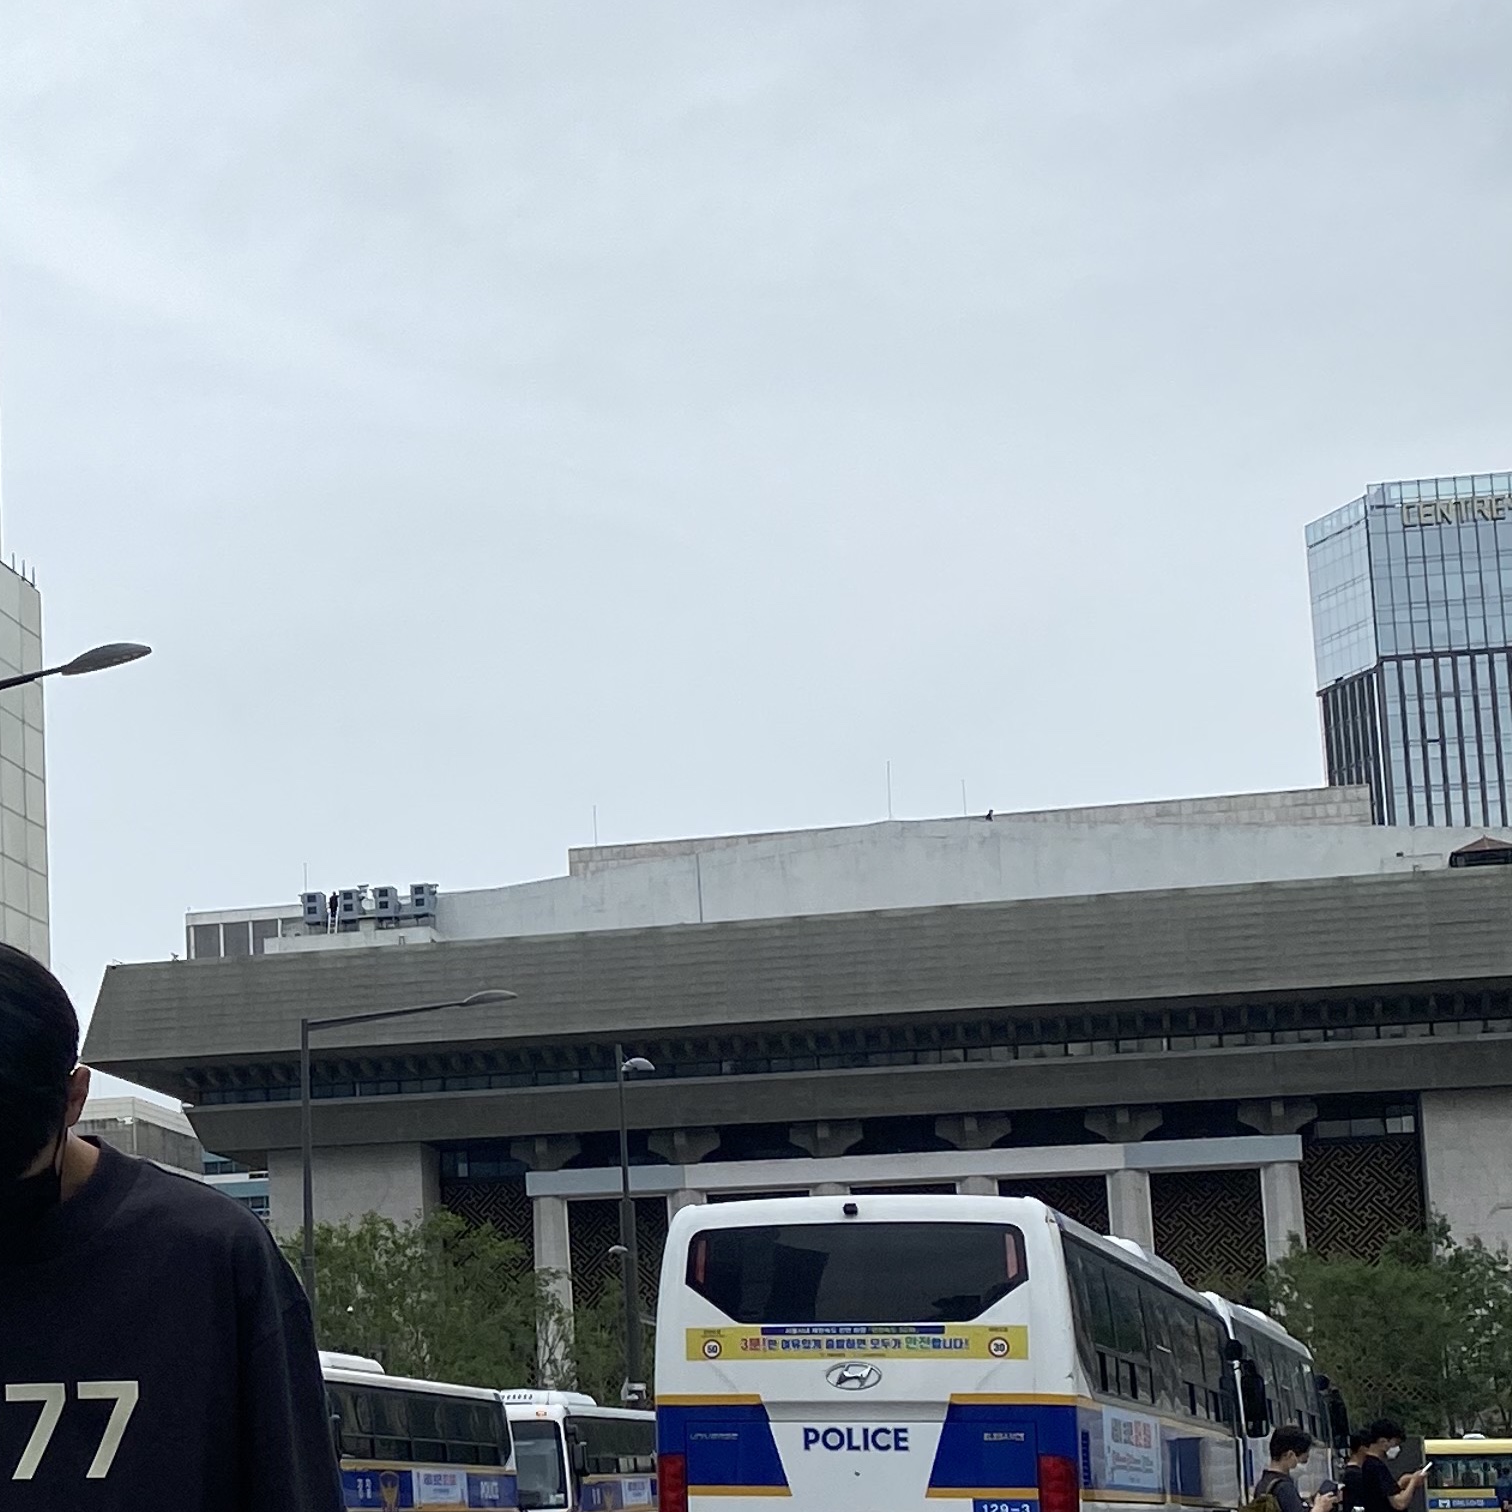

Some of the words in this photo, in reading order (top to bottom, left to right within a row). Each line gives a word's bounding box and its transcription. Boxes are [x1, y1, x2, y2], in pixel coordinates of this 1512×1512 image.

[706, 1344, 718, 1354] 50
[993, 1342, 1006, 1353] 30
[803, 1427, 910, 1451] POLICE
